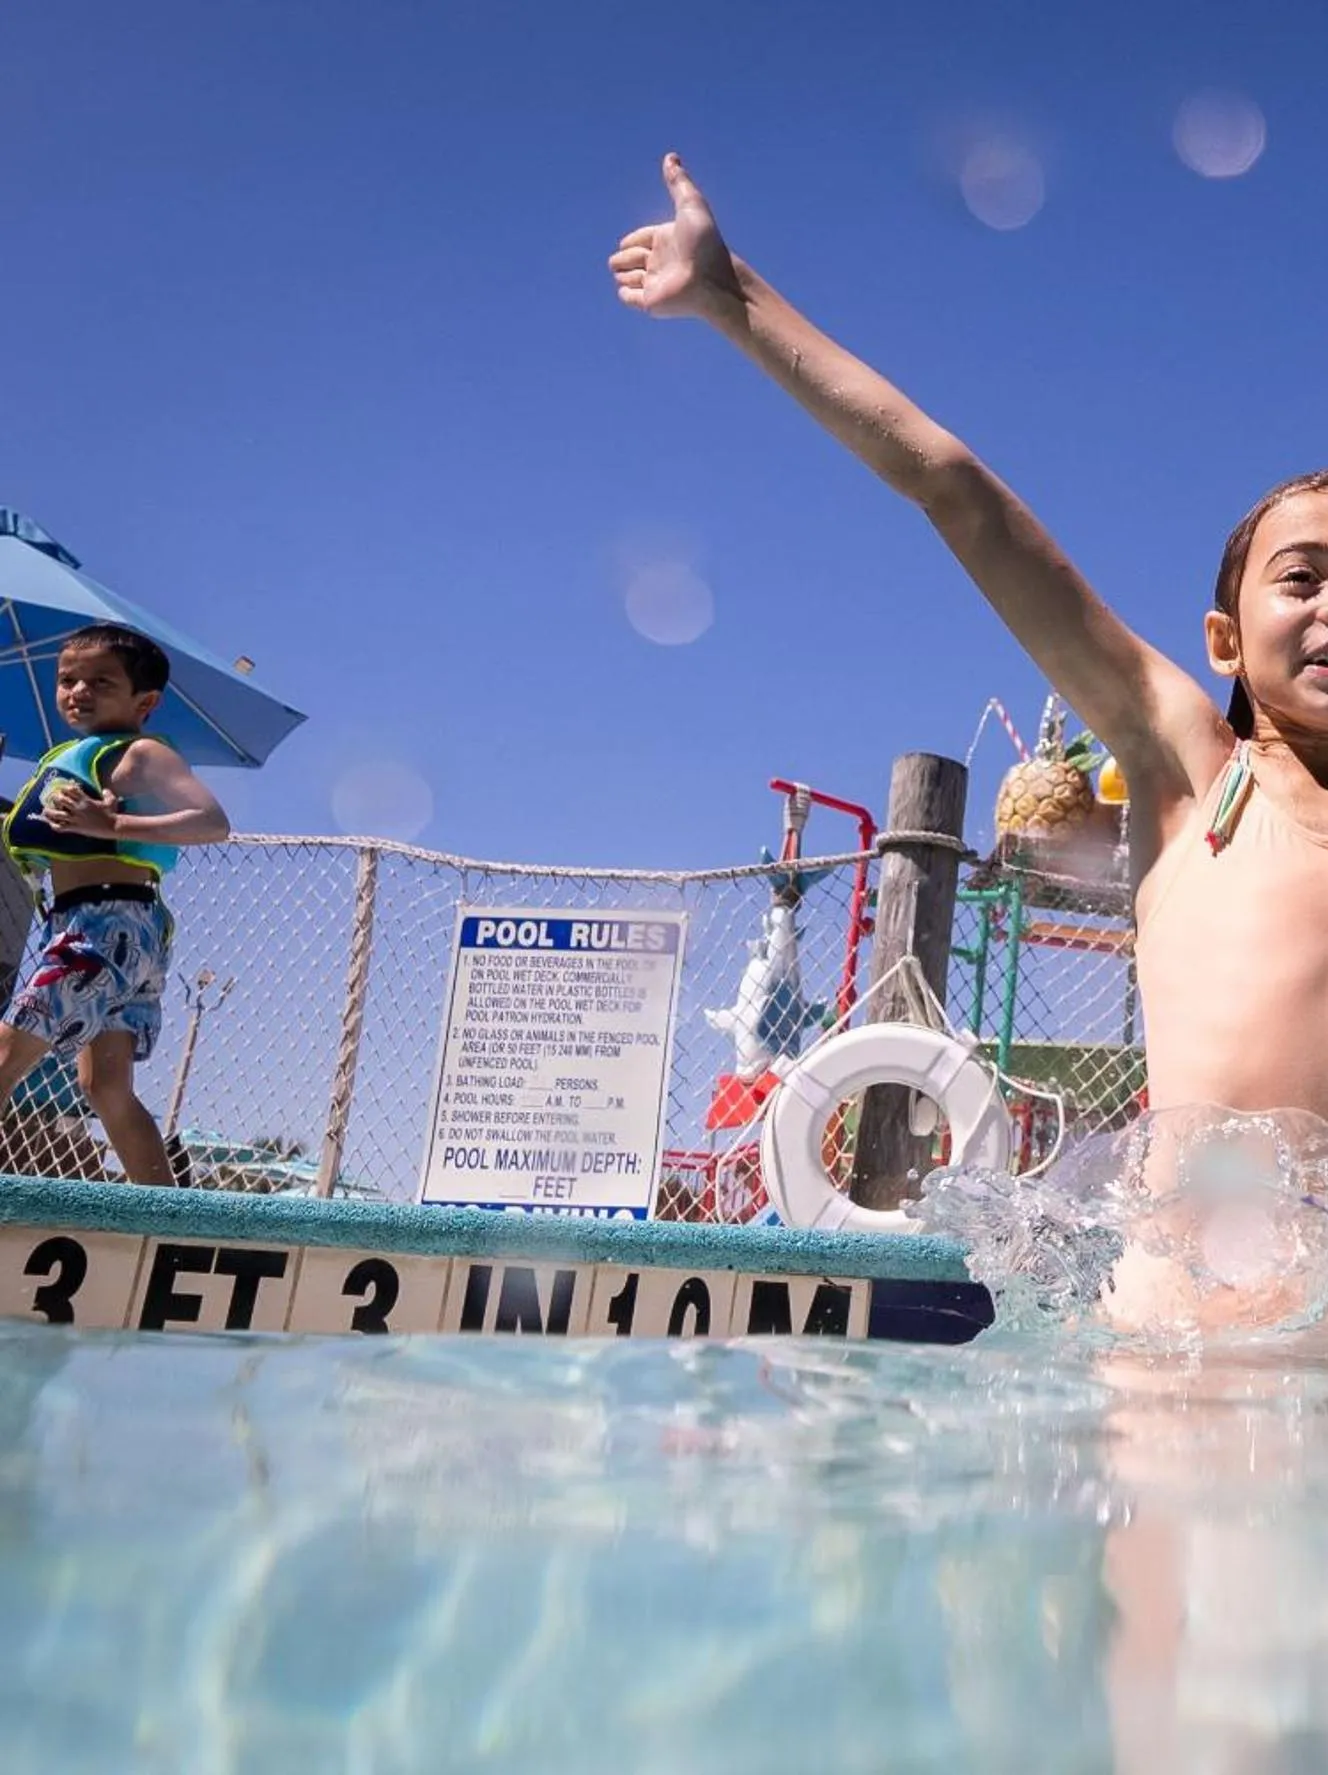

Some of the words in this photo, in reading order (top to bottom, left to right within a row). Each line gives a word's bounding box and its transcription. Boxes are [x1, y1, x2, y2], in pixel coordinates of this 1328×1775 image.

[476, 920, 554, 947] POOL
[570, 922, 666, 950] RULES
[473, 955, 486, 966] NO
[488, 955, 512, 967] FOOD
[515, 956, 528, 967] OR
[530, 956, 583, 969] BEVERAGES
[586, 957, 594, 969] IN
[598, 958, 614, 970] THE
[616, 959, 639, 971] POOL
[471, 969, 483, 980] ON
[487, 969, 510, 981] POOL
[513, 970, 532, 981] WET
[563, 971, 633, 984] COMMERCIALLY
[469, 982, 510, 994] BOTTLED
[512, 983, 543, 995] WATER
[545, 984, 554, 995] IN
[556, 985, 593, 997] PLASTIC
[595, 986, 635, 998] BOTTLES
[467, 997, 511, 1009] ALLOWED
[513, 998, 527, 1009] ON
[529, 998, 546, 1010] THE
[549, 999, 573, 1011] POOL
[575, 999, 594, 1011] WET
[596, 1000, 619, 1012] DECK
[623, 1001, 642, 1013] FOR
[466, 1009, 489, 1022] POOL
[492, 1010, 529, 1022] PATRON
[462, 1028, 476, 1040] NO
[478, 1028, 508, 1040] GLASS
[510, 1029, 523, 1041] OR
[526, 1030, 565, 1042] ANIMALS
[567, 1031, 576, 1042] IN
[579, 1031, 595, 1043] THE
[598, 1032, 634, 1044] FENCED
[636, 1033, 660, 1045] POOL
[461, 1041, 486, 1053] AREA
[519, 1043, 541, 1055] FEET
[595, 1045, 621, 1057] FROM
[458, 1056, 507, 1069] UNFENCED
[456, 1074, 496, 1088] BATHING
[453, 1092, 478, 1104] POOL
[569, 1095, 581, 1108] TO
[451, 1110, 492, 1123] SHOWER
[494, 1111, 531, 1124] BEFORE
[448, 1128, 462, 1139] DO
[464, 1128, 483, 1140] NOT
[485, 1129, 533, 1142] SWALLOW
[535, 1130, 553, 1142] THE
[554, 1130, 579, 1143] POOL
[443, 1147, 489, 1170] POOL
[495, 1148, 576, 1173] MAXIMUM
[580, 1152, 642, 1174] DEPTH:
[533, 1176, 577, 1199] FEET
[23, 1236, 87, 1324] 3
[138, 1244, 289, 1331] FT
[342, 1257, 400, 1334] 3
[459, 1264, 577, 1336] IN
[748, 1281, 852, 1336] M
